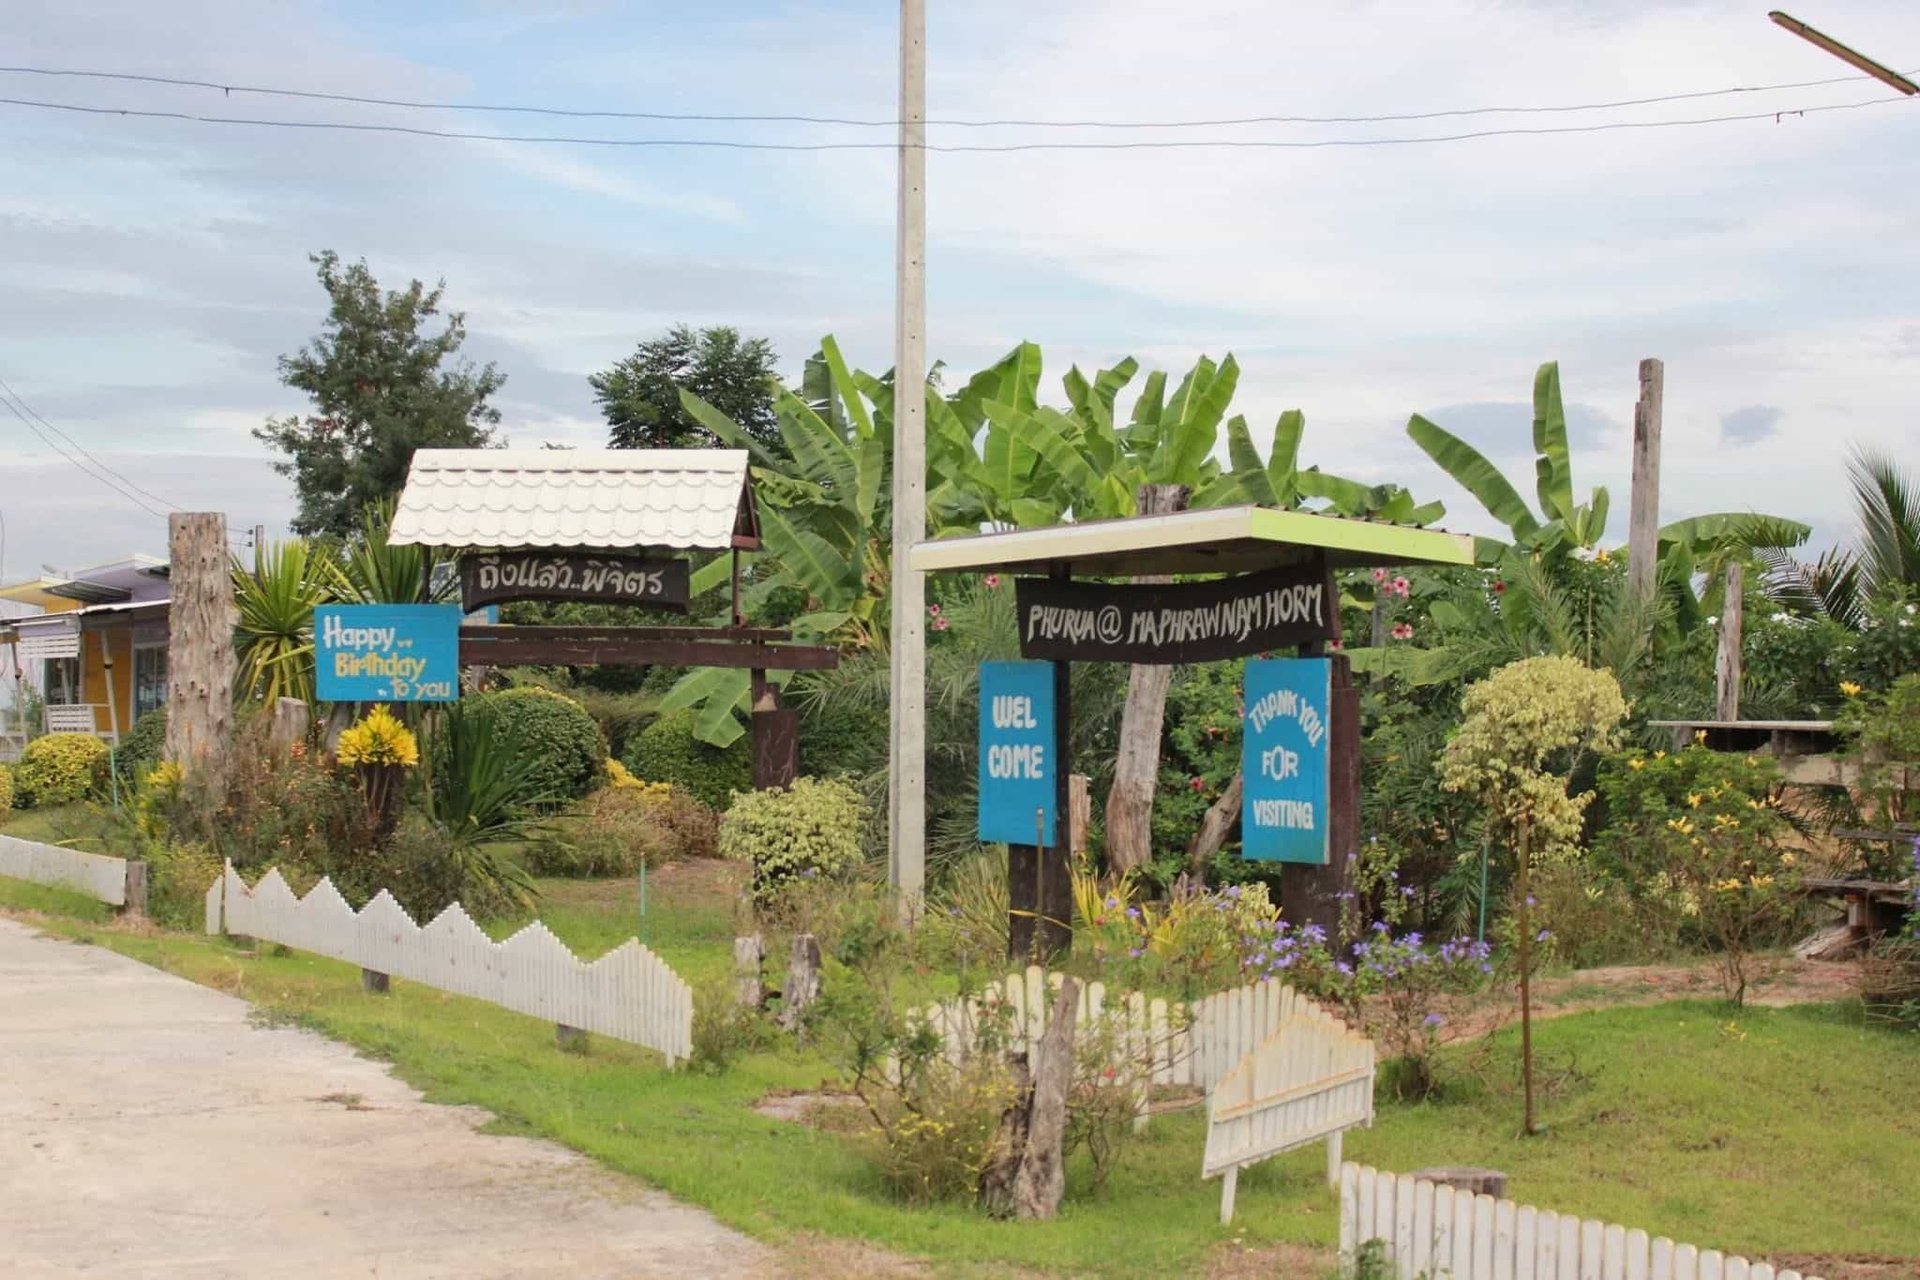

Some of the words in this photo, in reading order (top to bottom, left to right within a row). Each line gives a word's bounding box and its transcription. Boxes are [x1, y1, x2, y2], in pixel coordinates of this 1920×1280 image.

[1027, 605, 1096, 645] PHURUA
[1265, 583, 1324, 630] HORM
[323, 615, 395, 652] Happy
[335, 652, 427, 682] Birthday
[414, 682, 450, 700] you
[992, 696, 1037, 729] WEL
[1249, 689, 1298, 734] THANK
[1298, 698, 1325, 748] YOU
[988, 744, 1044, 779] COME
[1262, 745, 1298, 781] FOR
[1253, 800, 1314, 830] VISITING
